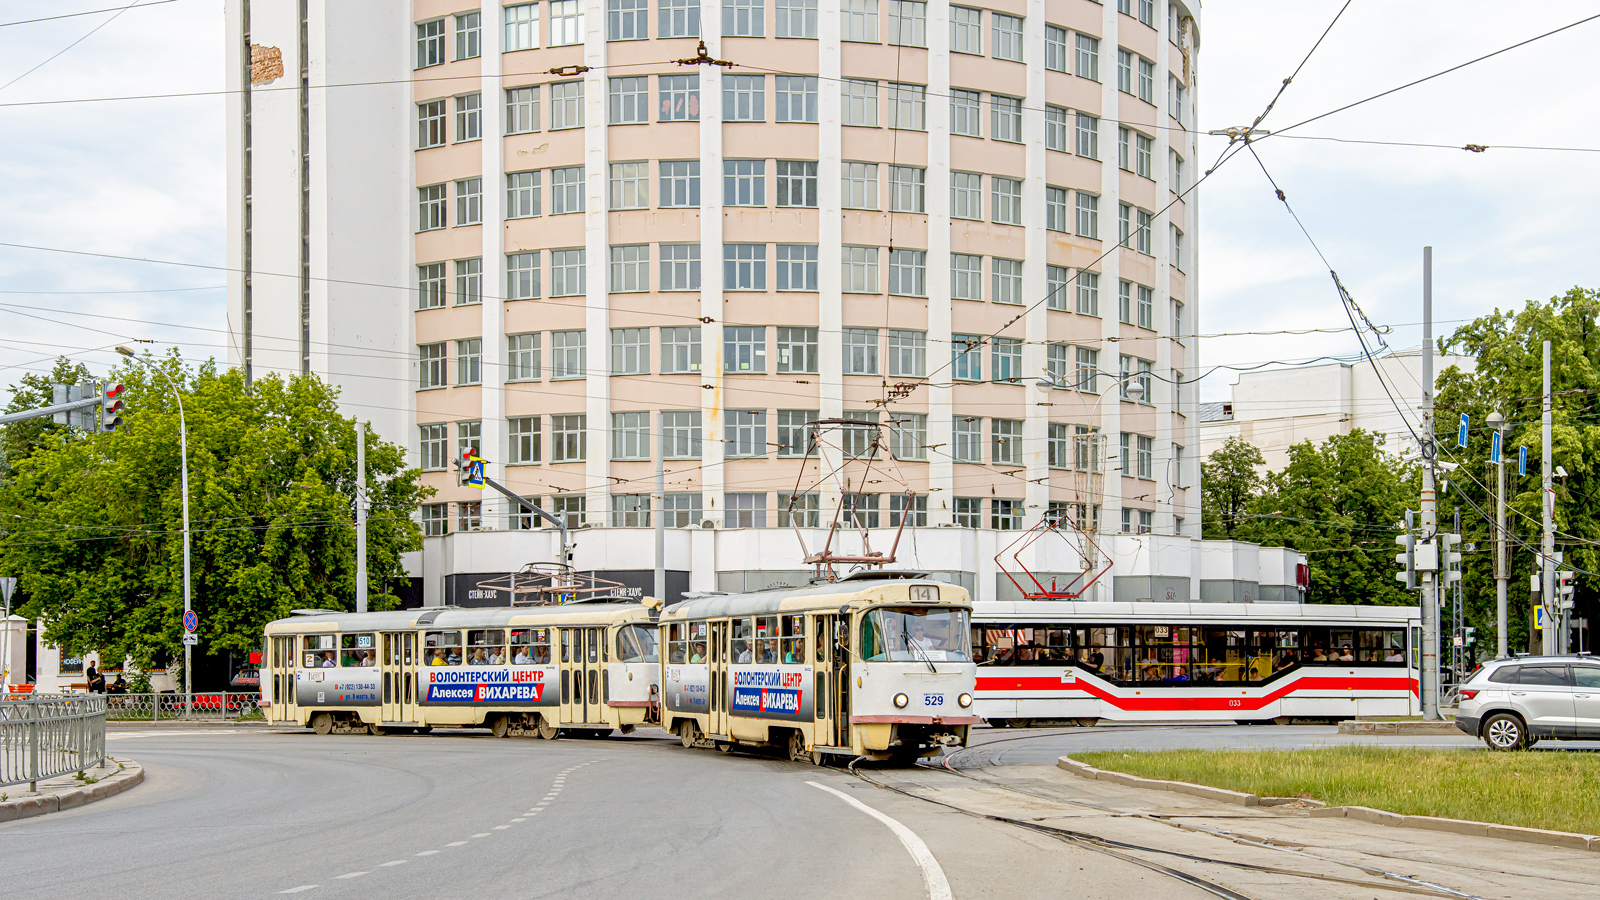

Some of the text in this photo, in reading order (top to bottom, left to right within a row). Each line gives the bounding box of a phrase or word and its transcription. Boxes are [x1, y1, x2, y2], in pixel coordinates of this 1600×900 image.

[914, 588, 930, 600] 14
[1155, 626, 1168, 634] 033
[359, 637, 370, 645] 510
[430, 669, 544, 683] ВОЛОНТЕРСКИЙ ЦЕНТР
[734, 669, 802, 689] ВОЛОНТЕРСКИЙ ЦЕНТР
[431, 686, 538, 699] Алексея ВИХАРЕВА
[735, 690, 799, 710] Алексея ВИХАРЕВА
[925, 696, 943, 705] 529
